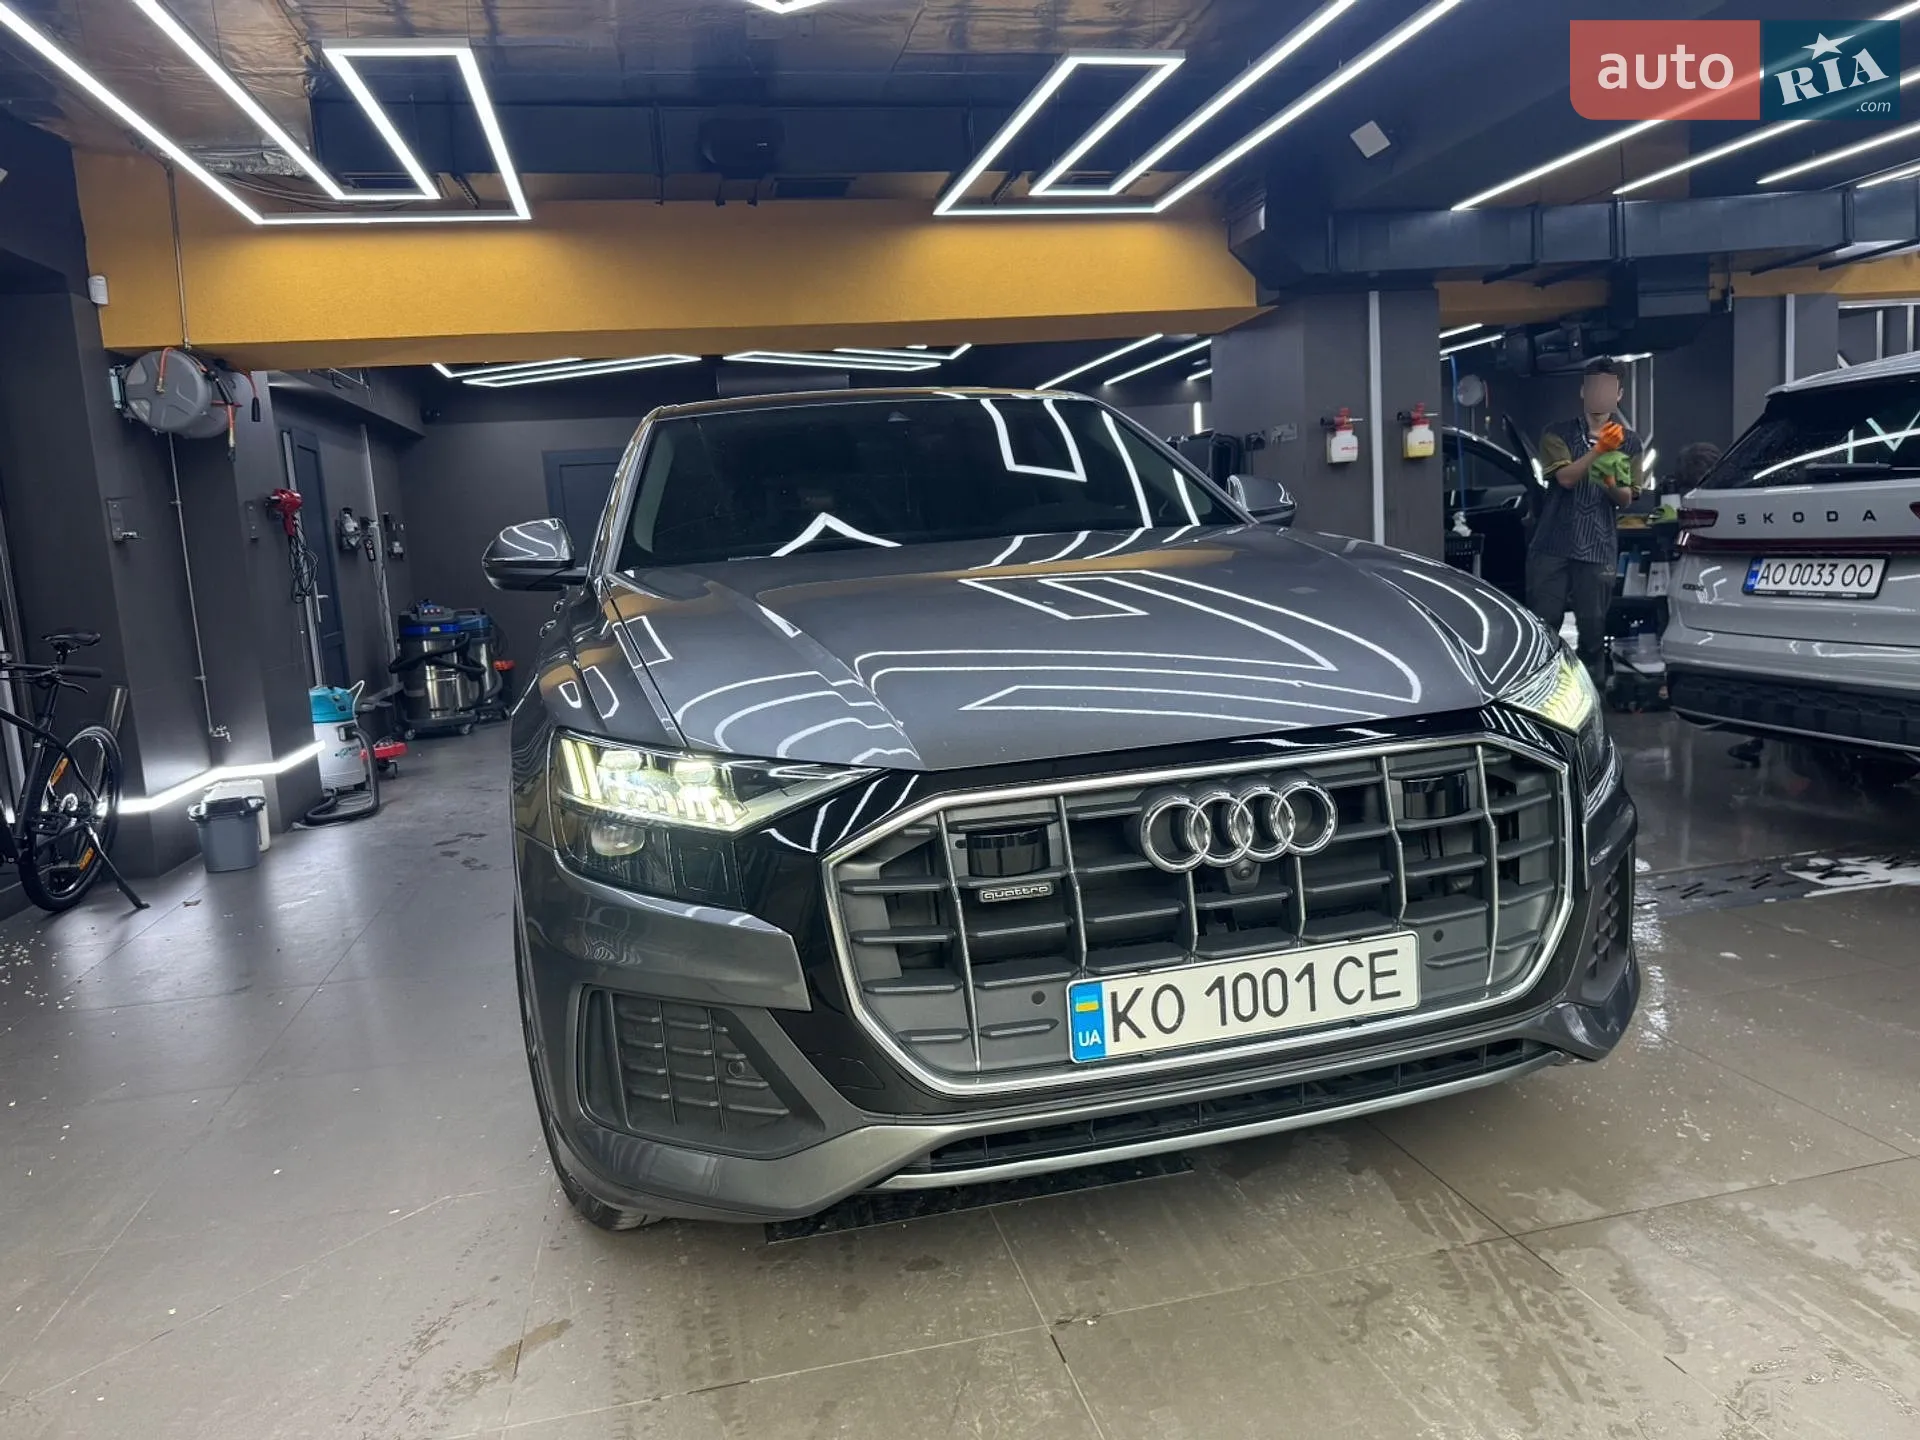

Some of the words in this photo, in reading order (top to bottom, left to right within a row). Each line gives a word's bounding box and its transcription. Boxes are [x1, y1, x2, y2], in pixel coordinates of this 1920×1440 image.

[1736, 509, 1877, 525] SKODA
[1758, 562, 1787, 585] AO
[1789, 562, 1838, 586] 0033
[1841, 563, 1873, 587] OO
[983, 885, 1049, 900] quattro
[1110, 984, 1186, 1043] KO
[1204, 962, 1317, 1026] 1001
[1333, 949, 1401, 1005] CE
[1078, 1031, 1103, 1047] UA
